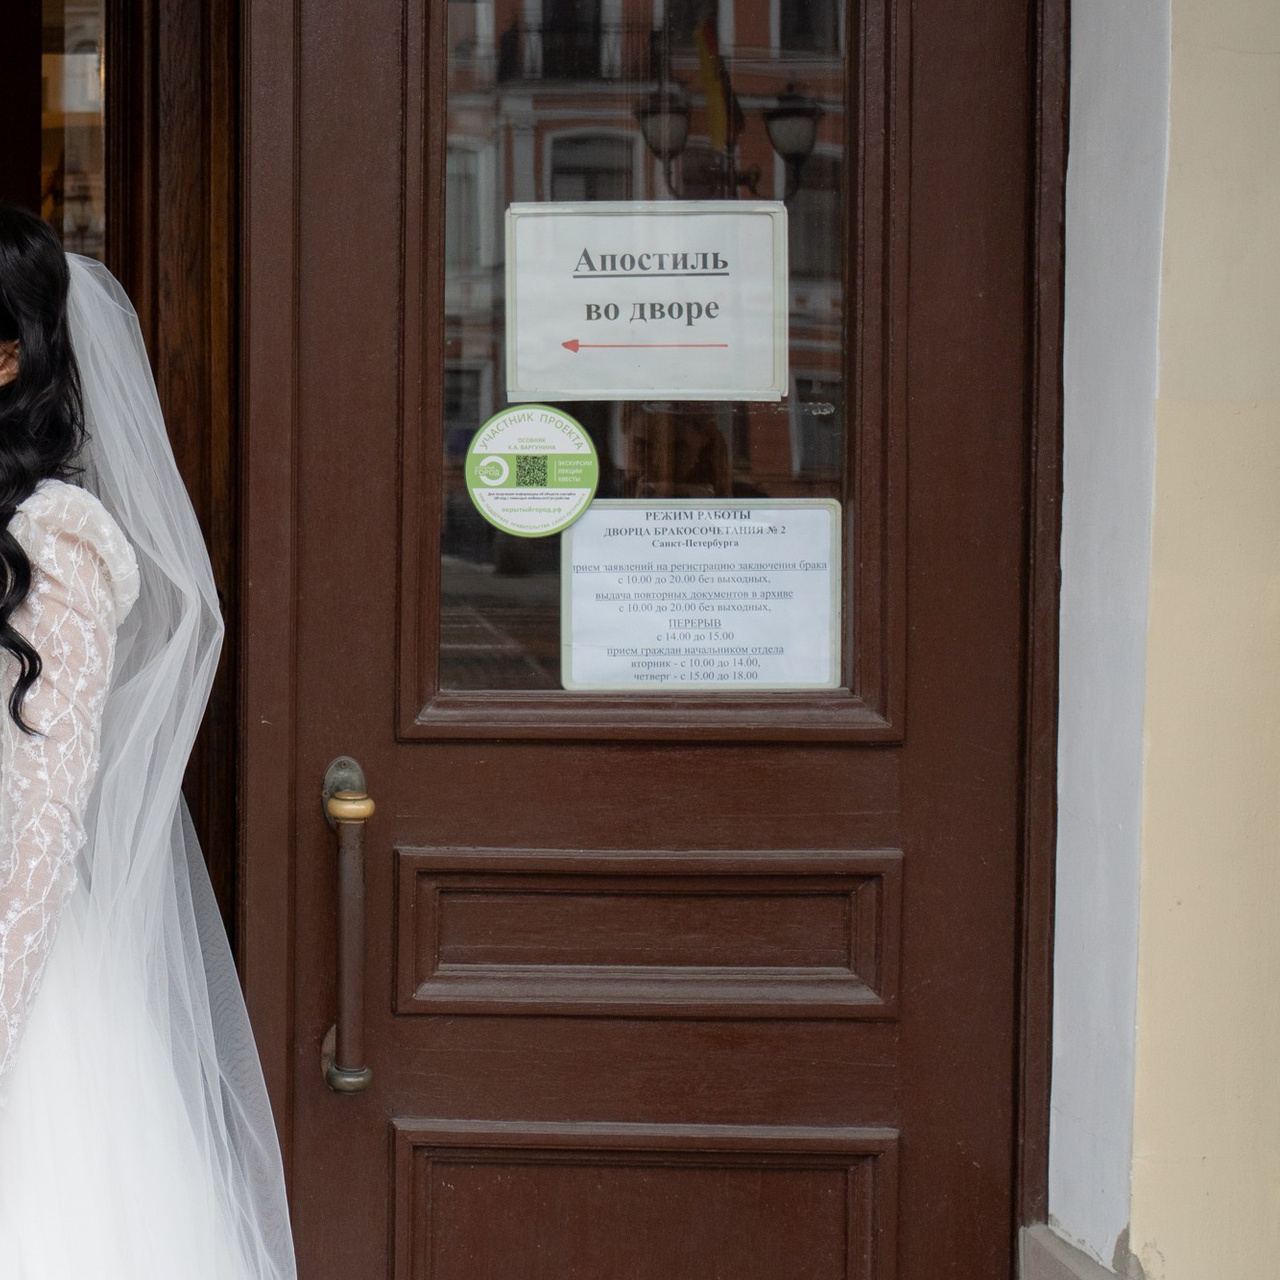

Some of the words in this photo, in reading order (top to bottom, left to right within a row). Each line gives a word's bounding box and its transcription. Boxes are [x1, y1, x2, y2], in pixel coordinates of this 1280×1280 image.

[573, 247, 729, 273] Апостиль
[585, 302, 620, 321] во
[629, 300, 720, 326] дворе
[479, 412, 534, 450] УЧАСТНИК
[540, 413, 584, 451] ПРОЕКТА
[646, 511, 693, 520] РЕЖИМ
[698, 511, 751, 520] РАБОТЫ
[604, 527, 650, 537] ДВОРЦА
[654, 526, 764, 536] БРАКОСОЧЕТАНИЯ
[781, 526, 786, 535] 2
[652, 539, 739, 548] Санкт-Петербурга
[603, 562, 653, 571] заявлений
[657, 563, 668, 571] на
[670, 562, 735, 572] регистрацию
[738, 562, 796, 570] заключения
[799, 561, 827, 570] брака
[626, 576, 652, 584] 10.00
[655, 576, 666, 585] до
[670, 575, 695, 584] 20.00
[699, 574, 715, 584] без
[595, 591, 631, 601] выдача
[634, 591, 687, 601] повторных
[691, 591, 748, 600] документов
[760, 591, 794, 600] архиве
[627, 603, 653, 612] 10.00
[655, 604, 667, 613] до
[670, 603, 696, 612] 20.00
[699, 602, 715, 612] без
[669, 619, 722, 629] ПЕРЕРЫВ
[666, 632, 691, 641] 14.00
[693, 632, 705, 641] до
[709, 632, 734, 641] 15.00
[607, 647, 638, 656] прием
[640, 646, 681, 656] граждан
[685, 646, 748, 655] начальником
[751, 646, 784, 655] отдела
[631, 659, 670, 669] вторник
[689, 658, 715, 668] 10.00
[717, 659, 729, 668] до
[634, 672, 670, 682] четверг
[689, 671, 714, 680] 15.00
[717, 672, 729, 681] до
[733, 671, 758, 680] 18.00
